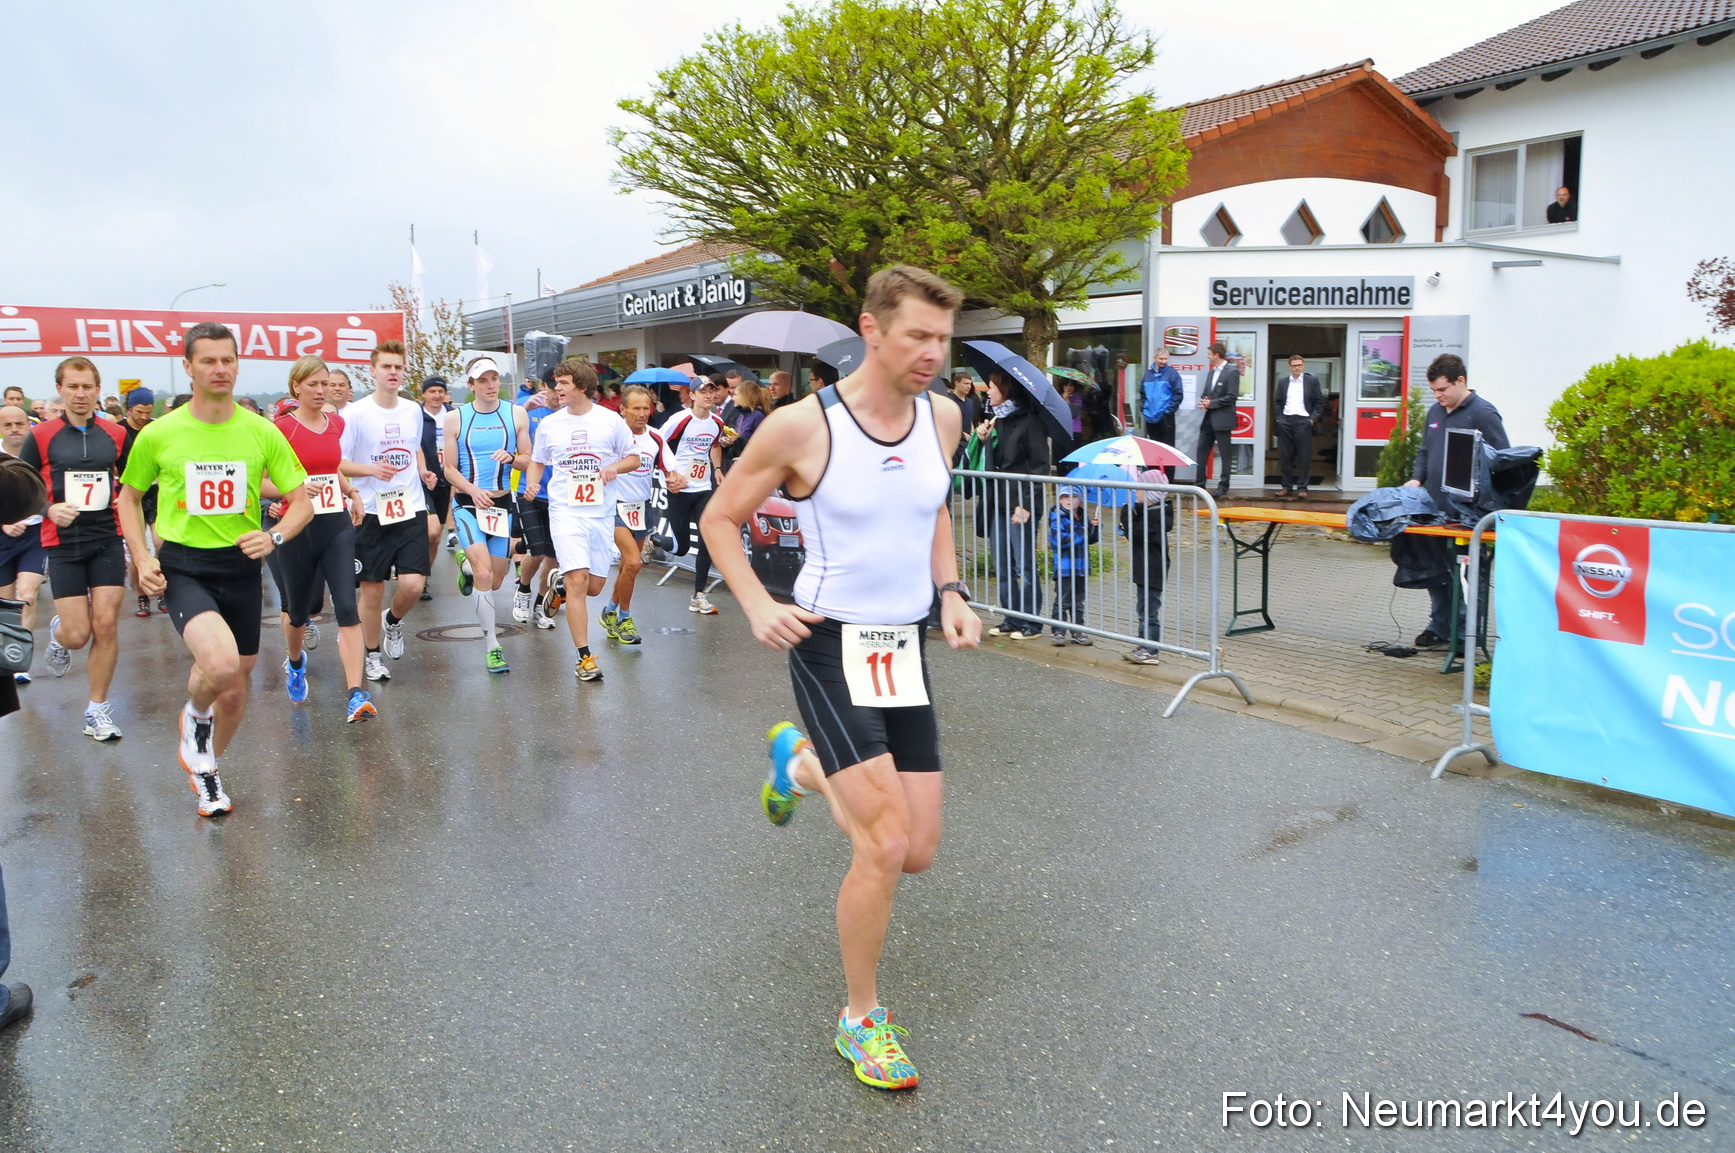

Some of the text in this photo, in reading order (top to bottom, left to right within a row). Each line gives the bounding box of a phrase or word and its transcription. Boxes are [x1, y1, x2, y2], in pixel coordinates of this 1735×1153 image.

[623, 275, 745, 316] Gerhart & Jänig
[1212, 279, 1410, 306] Serviceannahme
[690, 464, 706, 479] 38
[82, 484, 94, 505] 7
[200, 480, 234, 510] 68
[319, 486, 335, 508] 12
[575, 484, 595, 502] 42
[385, 499, 406, 519] 43
[627, 511, 639, 527] 18
[485, 515, 498, 532] 17
[1577, 564, 1625, 578] NISSAN
[859, 631, 896, 640] MEYER
[866, 652, 897, 697] 11
